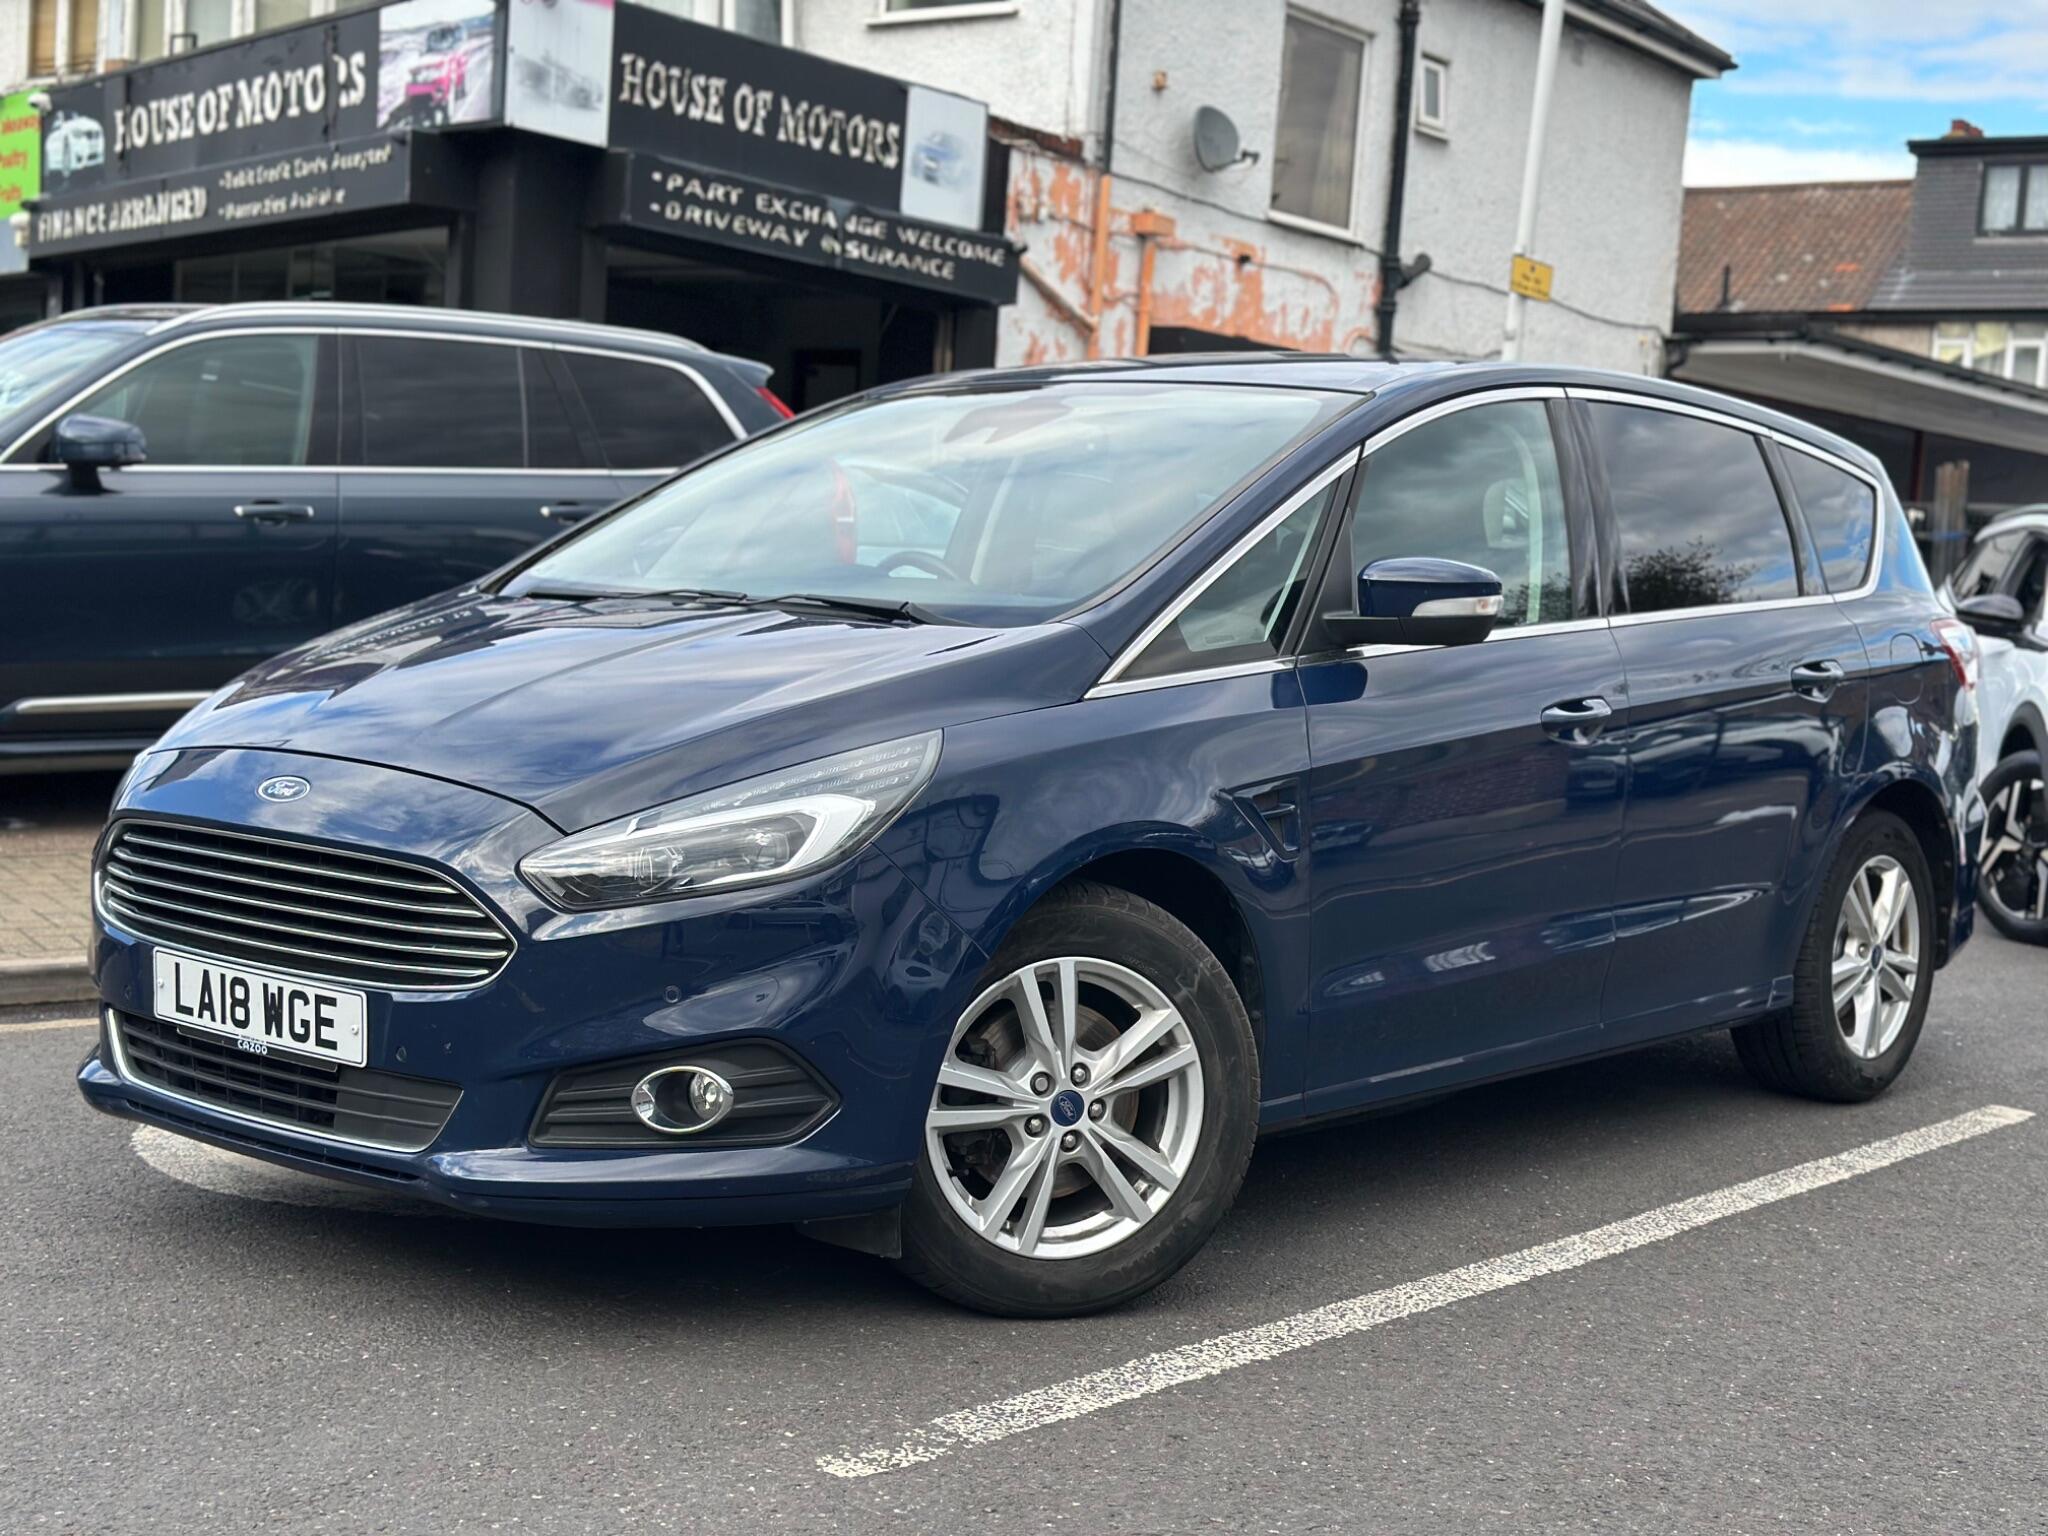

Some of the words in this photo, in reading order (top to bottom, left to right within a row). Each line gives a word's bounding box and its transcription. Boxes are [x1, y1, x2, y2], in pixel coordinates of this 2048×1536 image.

[114, 91, 195, 153] HOUSE
[197, 82, 233, 135] OF
[619, 53, 728, 125] HOUSE
[733, 82, 774, 136] OF
[776, 94, 900, 170] MOTORS
[38, 203, 106, 243] FINANCE
[108, 186, 207, 232] ARRANGED
[664, 200, 809, 247] DRIVEWAY
[666, 173, 744, 206] PART
[896, 226, 1007, 267] WELCOME
[267, 780, 300, 796] Ford
[174, 961, 251, 1030] LA18
[262, 982, 338, 1051] WGE
[237, 1039, 268, 1056] CAZOO
